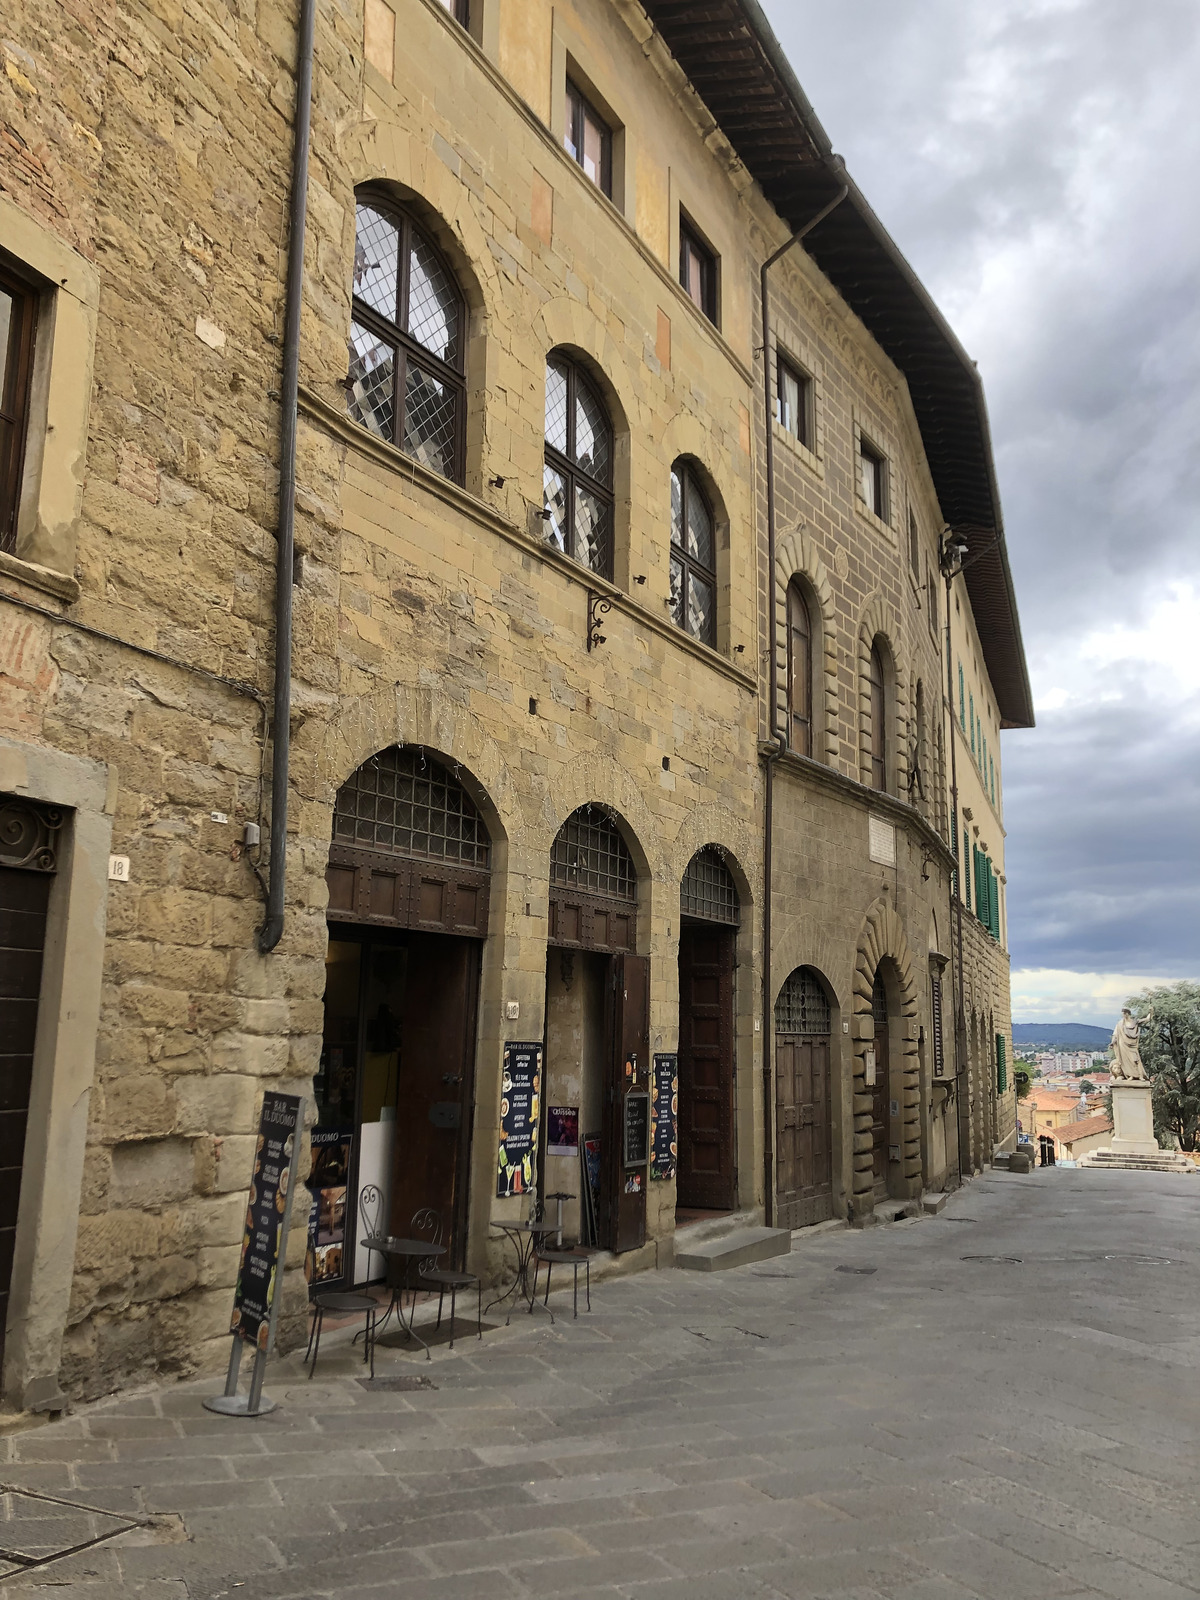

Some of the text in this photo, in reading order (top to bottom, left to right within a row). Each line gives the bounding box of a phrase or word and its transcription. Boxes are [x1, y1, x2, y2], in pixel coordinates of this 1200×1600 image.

[113, 860, 124, 876] 18
[273, 1100, 288, 1113] BAR
[263, 1110, 296, 1128] IL DUOMO
[311, 1132, 339, 1144] DUOMO
